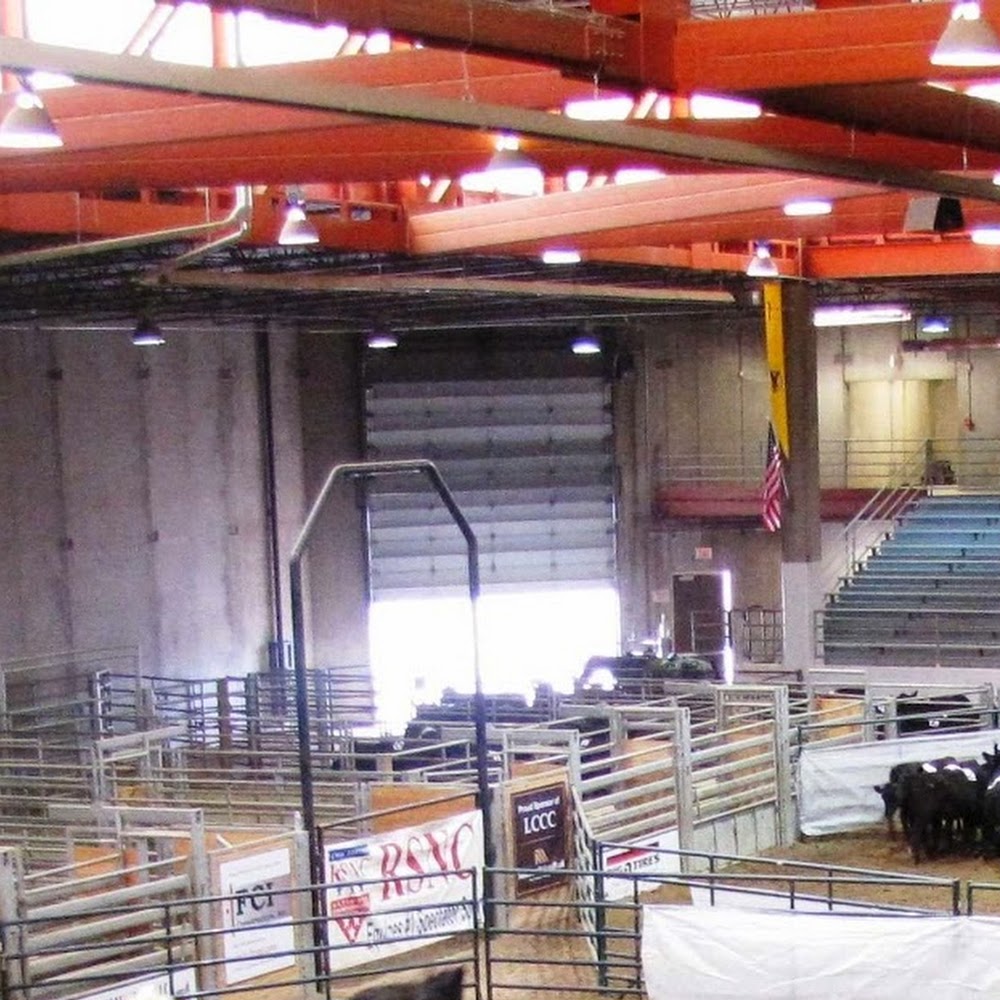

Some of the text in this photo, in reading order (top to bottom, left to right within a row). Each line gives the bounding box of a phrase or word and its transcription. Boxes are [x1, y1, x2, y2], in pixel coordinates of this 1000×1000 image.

[524, 810, 557, 834] LCCC
[380, 822, 474, 900] RSNC
[633, 853, 660, 870] TIRES
[235, 881, 274, 916] FCI
